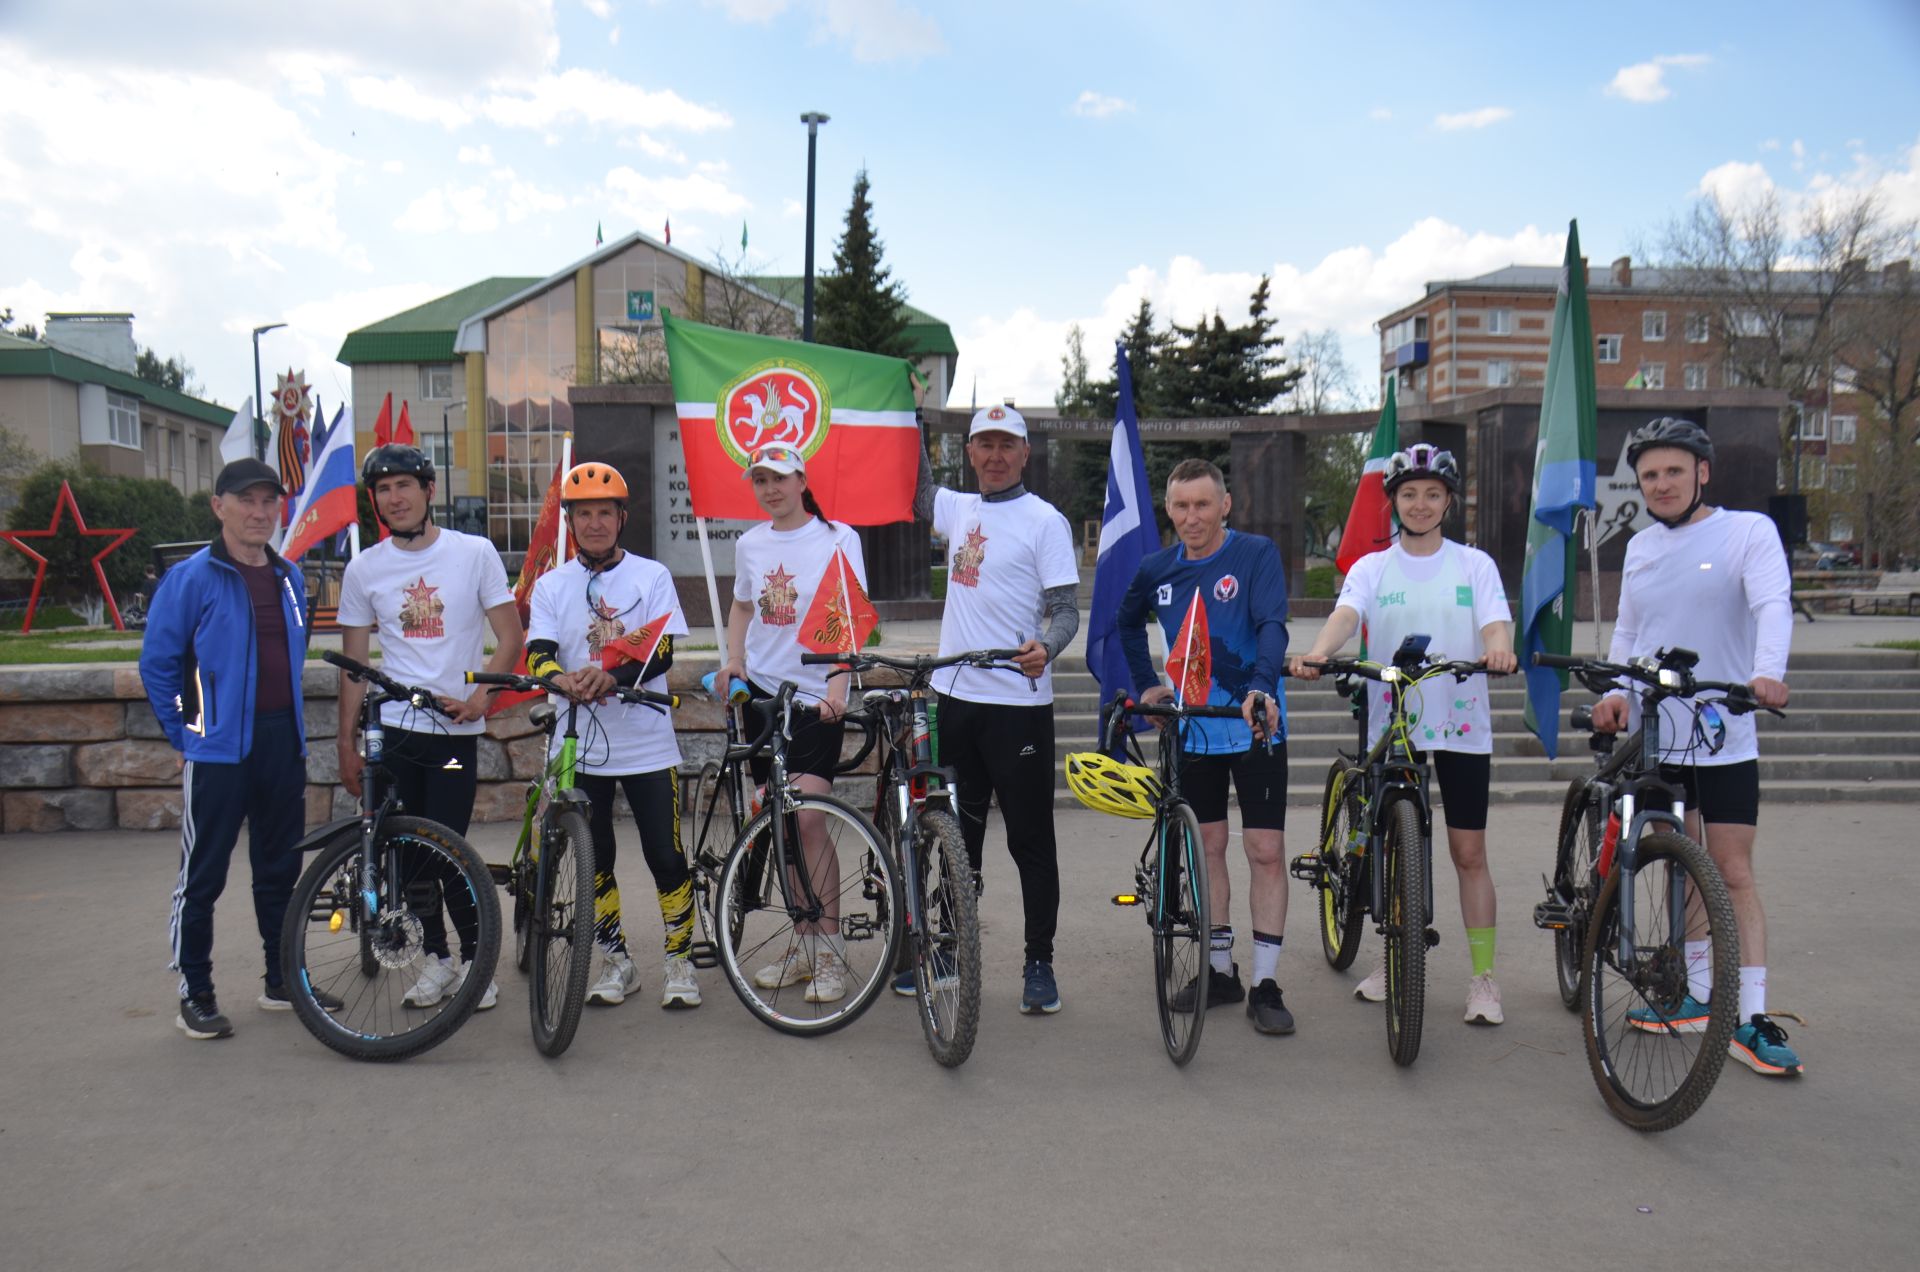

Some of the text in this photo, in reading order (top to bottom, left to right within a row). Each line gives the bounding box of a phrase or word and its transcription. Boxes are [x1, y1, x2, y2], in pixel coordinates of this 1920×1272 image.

[670, 431, 678, 440] Я
[669, 465, 677, 474] И
[670, 498, 677, 507] У
[671, 531, 678, 540] У
